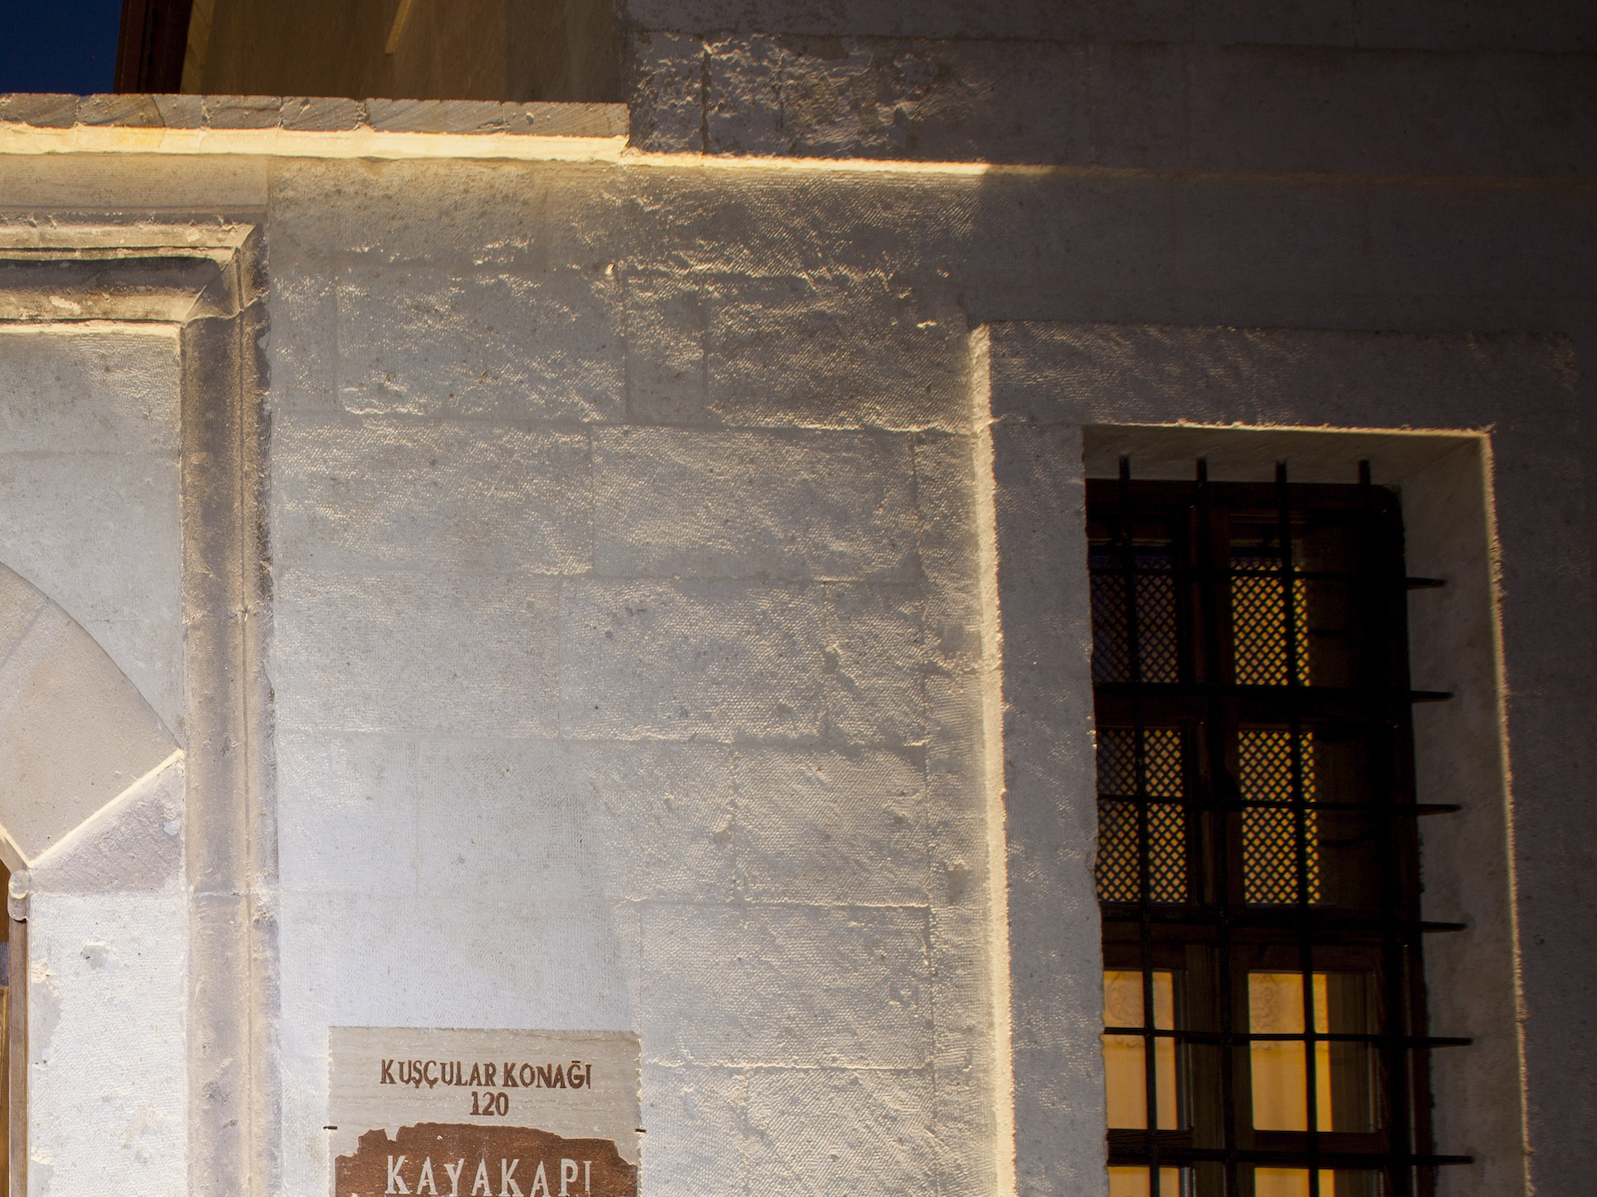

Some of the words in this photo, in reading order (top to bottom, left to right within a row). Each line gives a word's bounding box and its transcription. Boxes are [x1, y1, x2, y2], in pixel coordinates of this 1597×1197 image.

[380, 1059, 496, 1088] KUŞÇULAR
[502, 1060, 591, 1089] KONAĞI
[470, 1091, 509, 1116] 120
